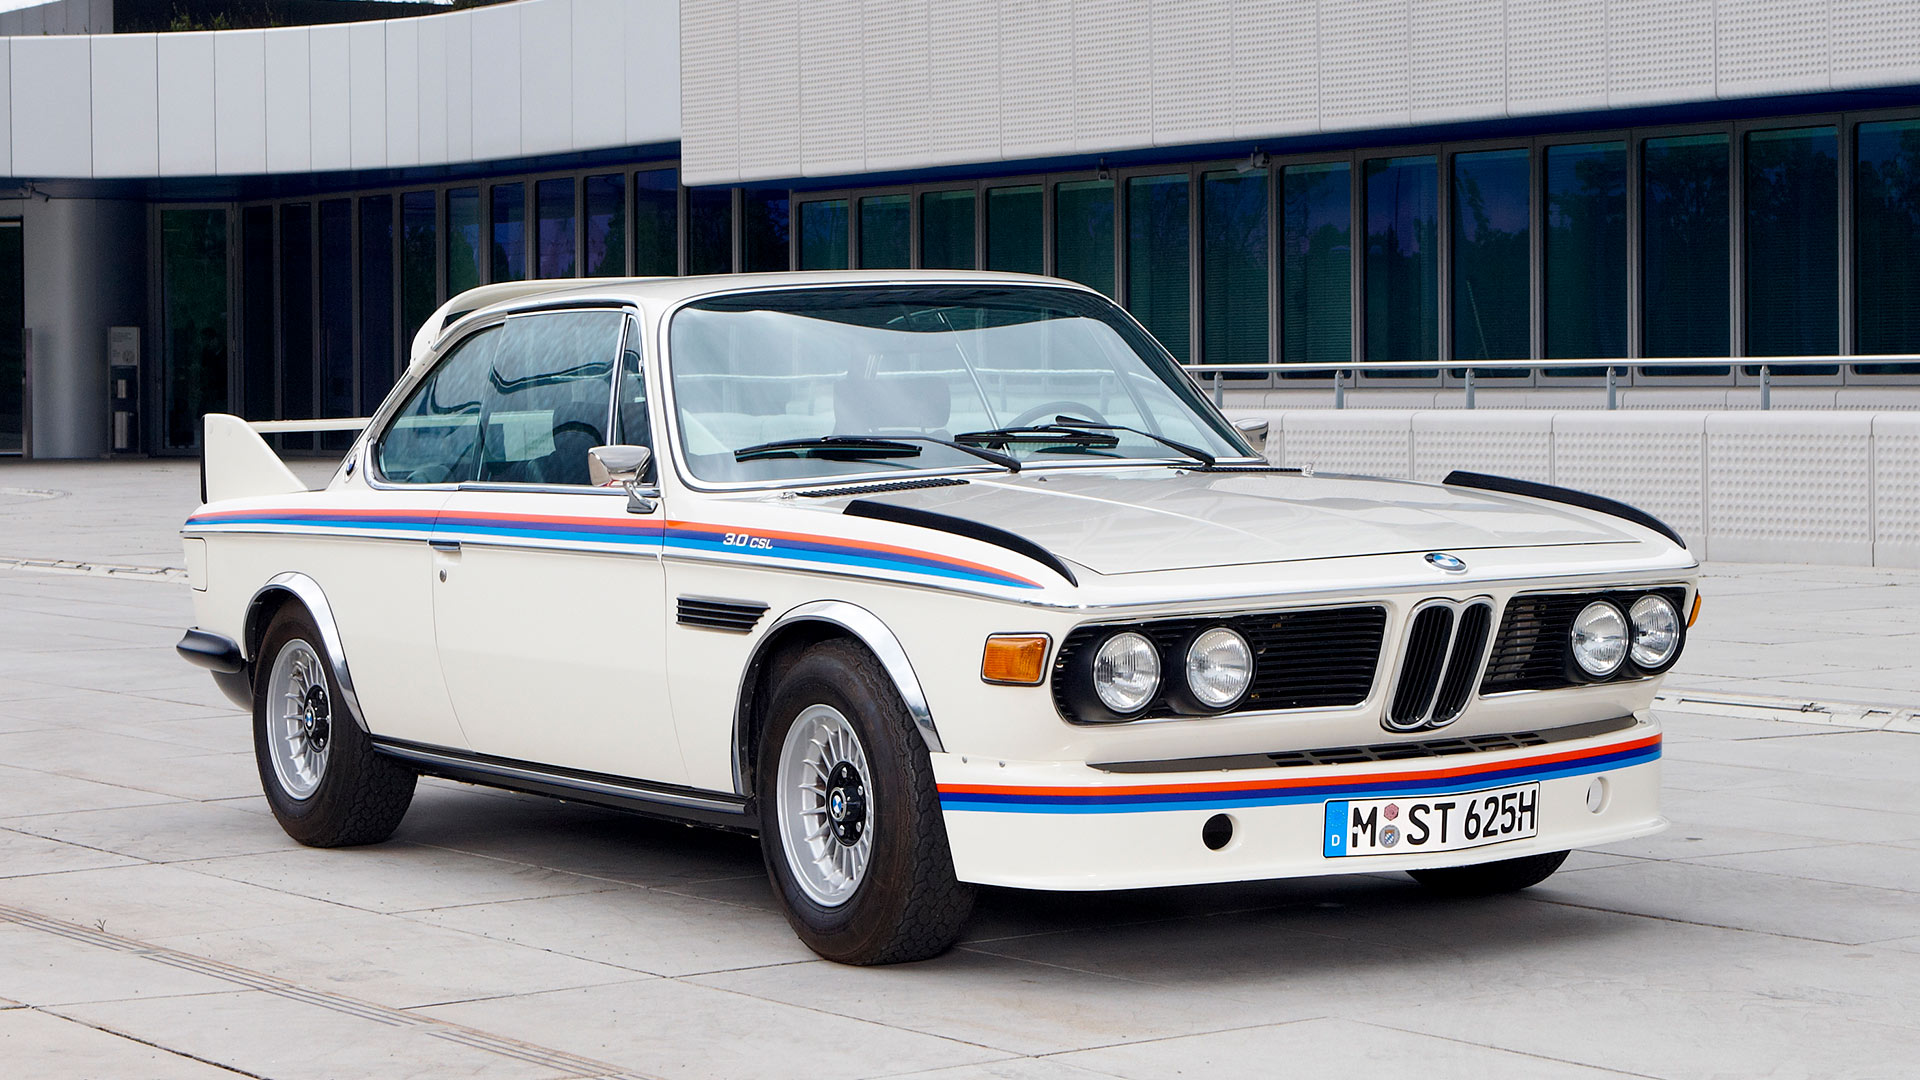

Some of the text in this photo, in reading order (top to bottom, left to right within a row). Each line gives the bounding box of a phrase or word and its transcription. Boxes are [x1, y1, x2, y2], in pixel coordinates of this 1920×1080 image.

[723, 532, 773, 550] 3.0 CSL
[1331, 789, 1537, 848] D M ST 625H
